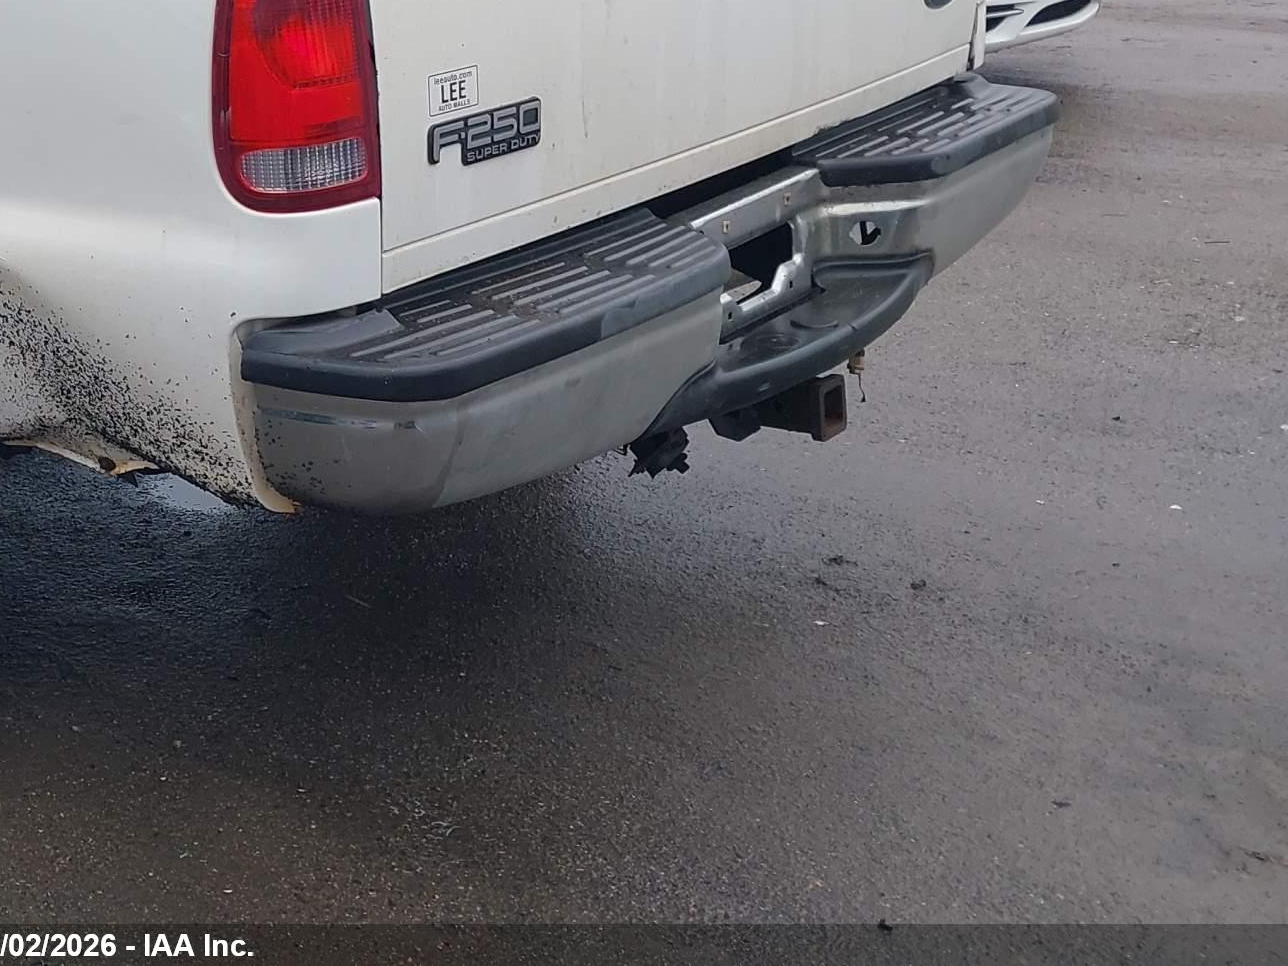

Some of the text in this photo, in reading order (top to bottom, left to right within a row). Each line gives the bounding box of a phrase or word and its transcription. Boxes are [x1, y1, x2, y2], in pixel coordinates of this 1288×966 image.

[434, 71, 472, 85] leeauto.com
[440, 80, 467, 103] LEE
[438, 102, 453, 112] AUTO
[467, 133, 539, 162] SUPER DUTY
